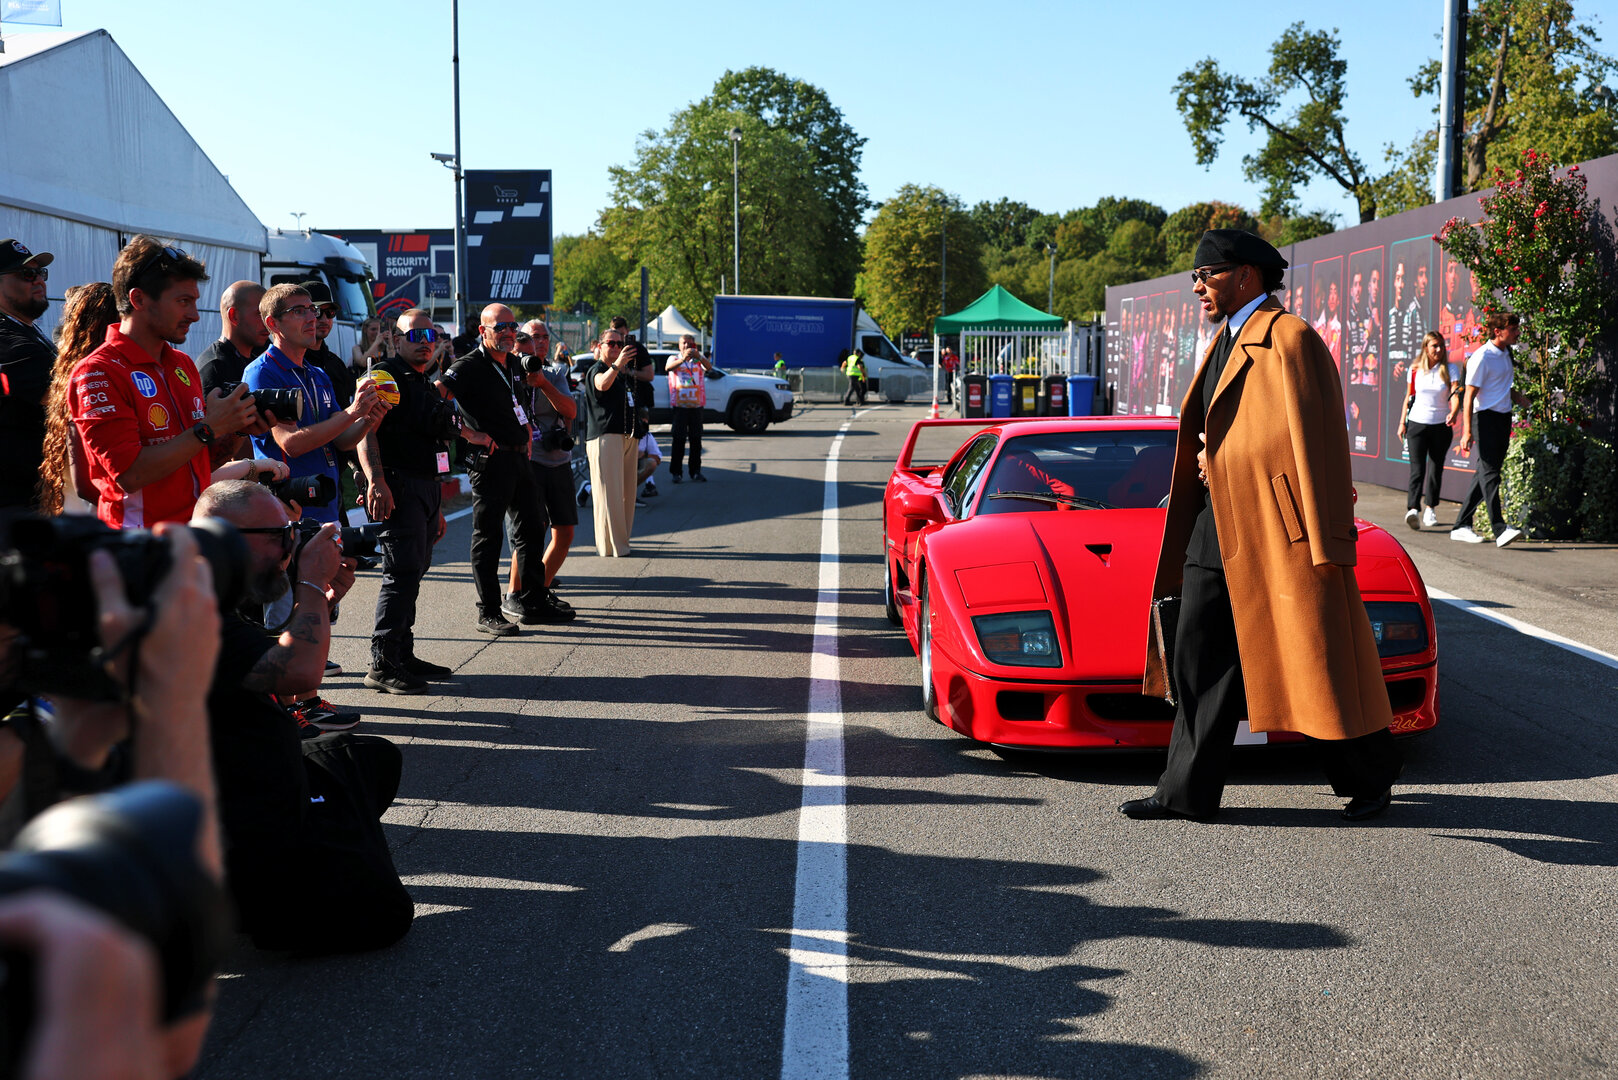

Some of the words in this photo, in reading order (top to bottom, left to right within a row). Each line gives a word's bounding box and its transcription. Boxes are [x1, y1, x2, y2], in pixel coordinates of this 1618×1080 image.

[386, 257, 429, 266] SECURITY
[386, 267, 413, 276] POINT
[490, 269, 504, 284] THE
[504, 269, 531, 284] TEMPLE
[490, 284, 500, 298] OF
[500, 284, 524, 298] SPEED
[766, 320, 825, 336] megam
[134, 372, 153, 397] hp
